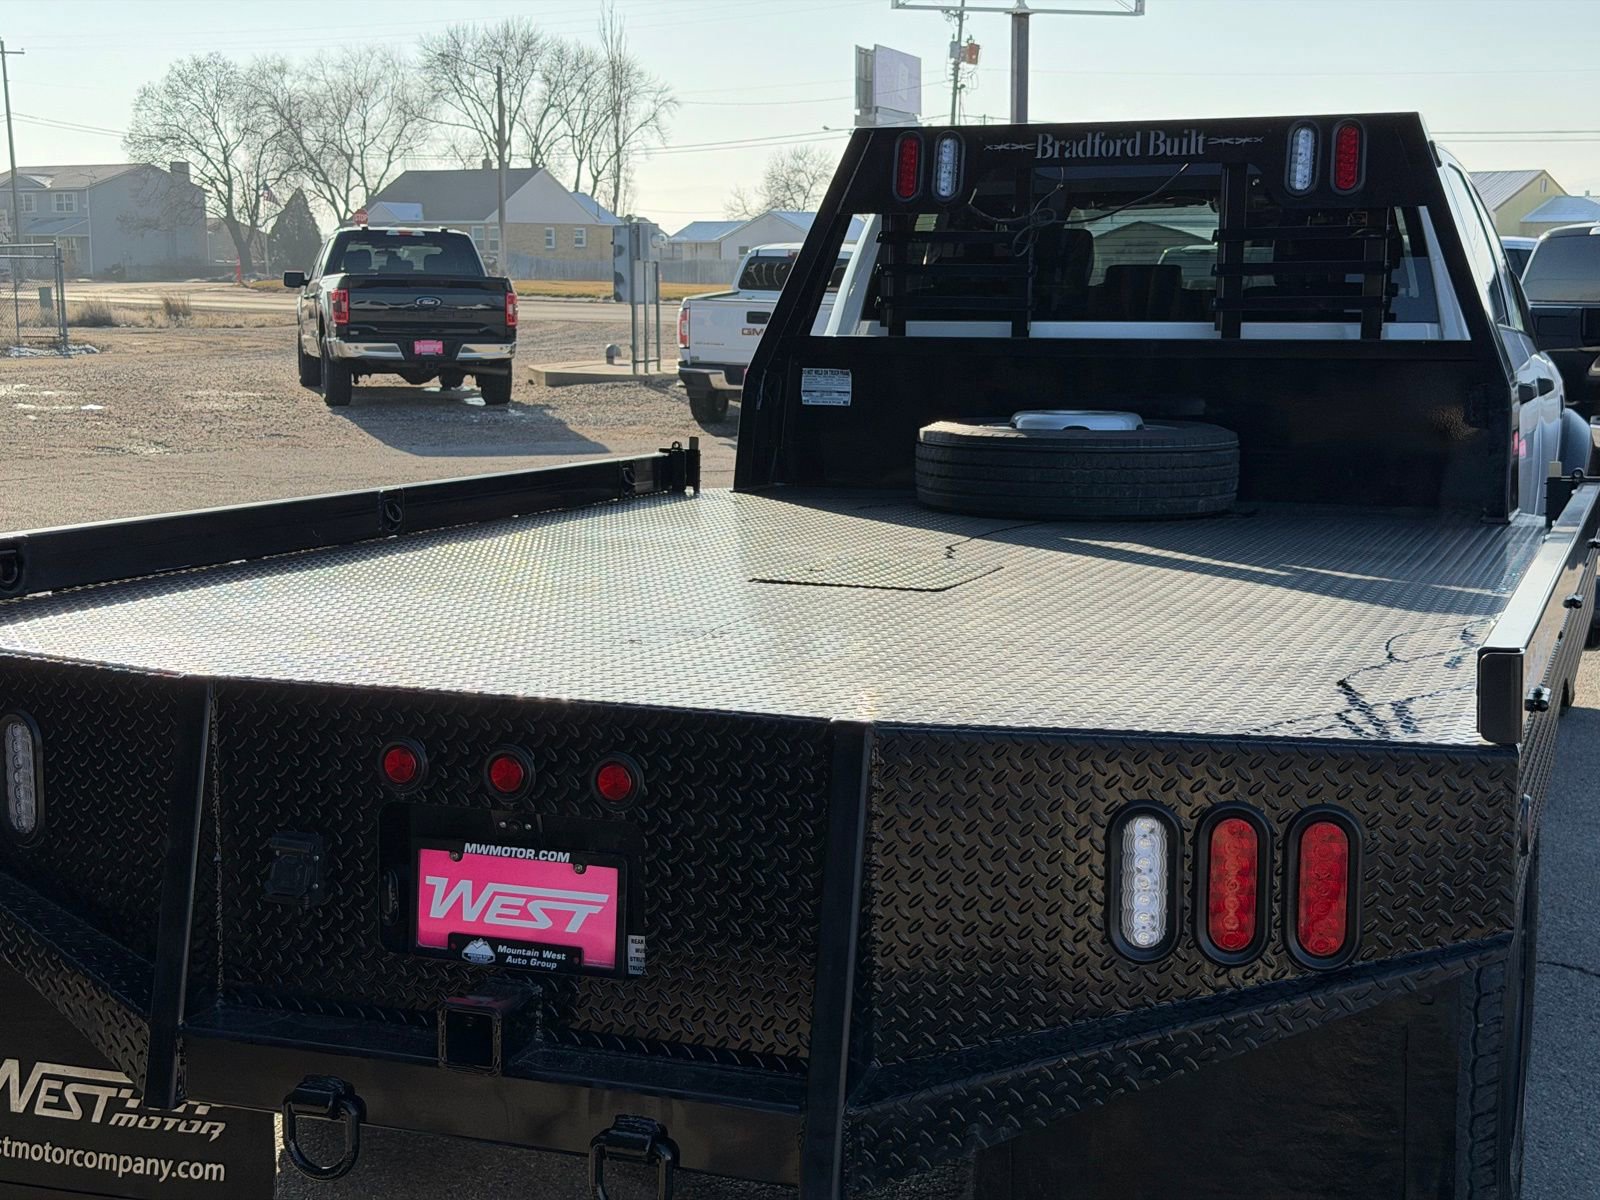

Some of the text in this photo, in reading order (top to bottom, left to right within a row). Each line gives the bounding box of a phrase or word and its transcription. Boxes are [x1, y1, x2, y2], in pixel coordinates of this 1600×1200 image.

[1035, 128, 1206, 159] Bradford Built
[741, 327, 765, 336] GM
[463, 842, 570, 863] MWMOTOR.COM
[425, 875, 609, 934] WEST
[497, 944, 540, 958] Mountain
[542, 949, 567, 961] West
[506, 955, 558, 970] Auto Group
[0, 1058, 134, 1123] WEST
[109, 1112, 226, 1142] MOTOR
[0, 1135, 226, 1183] tmotorcompany.com
